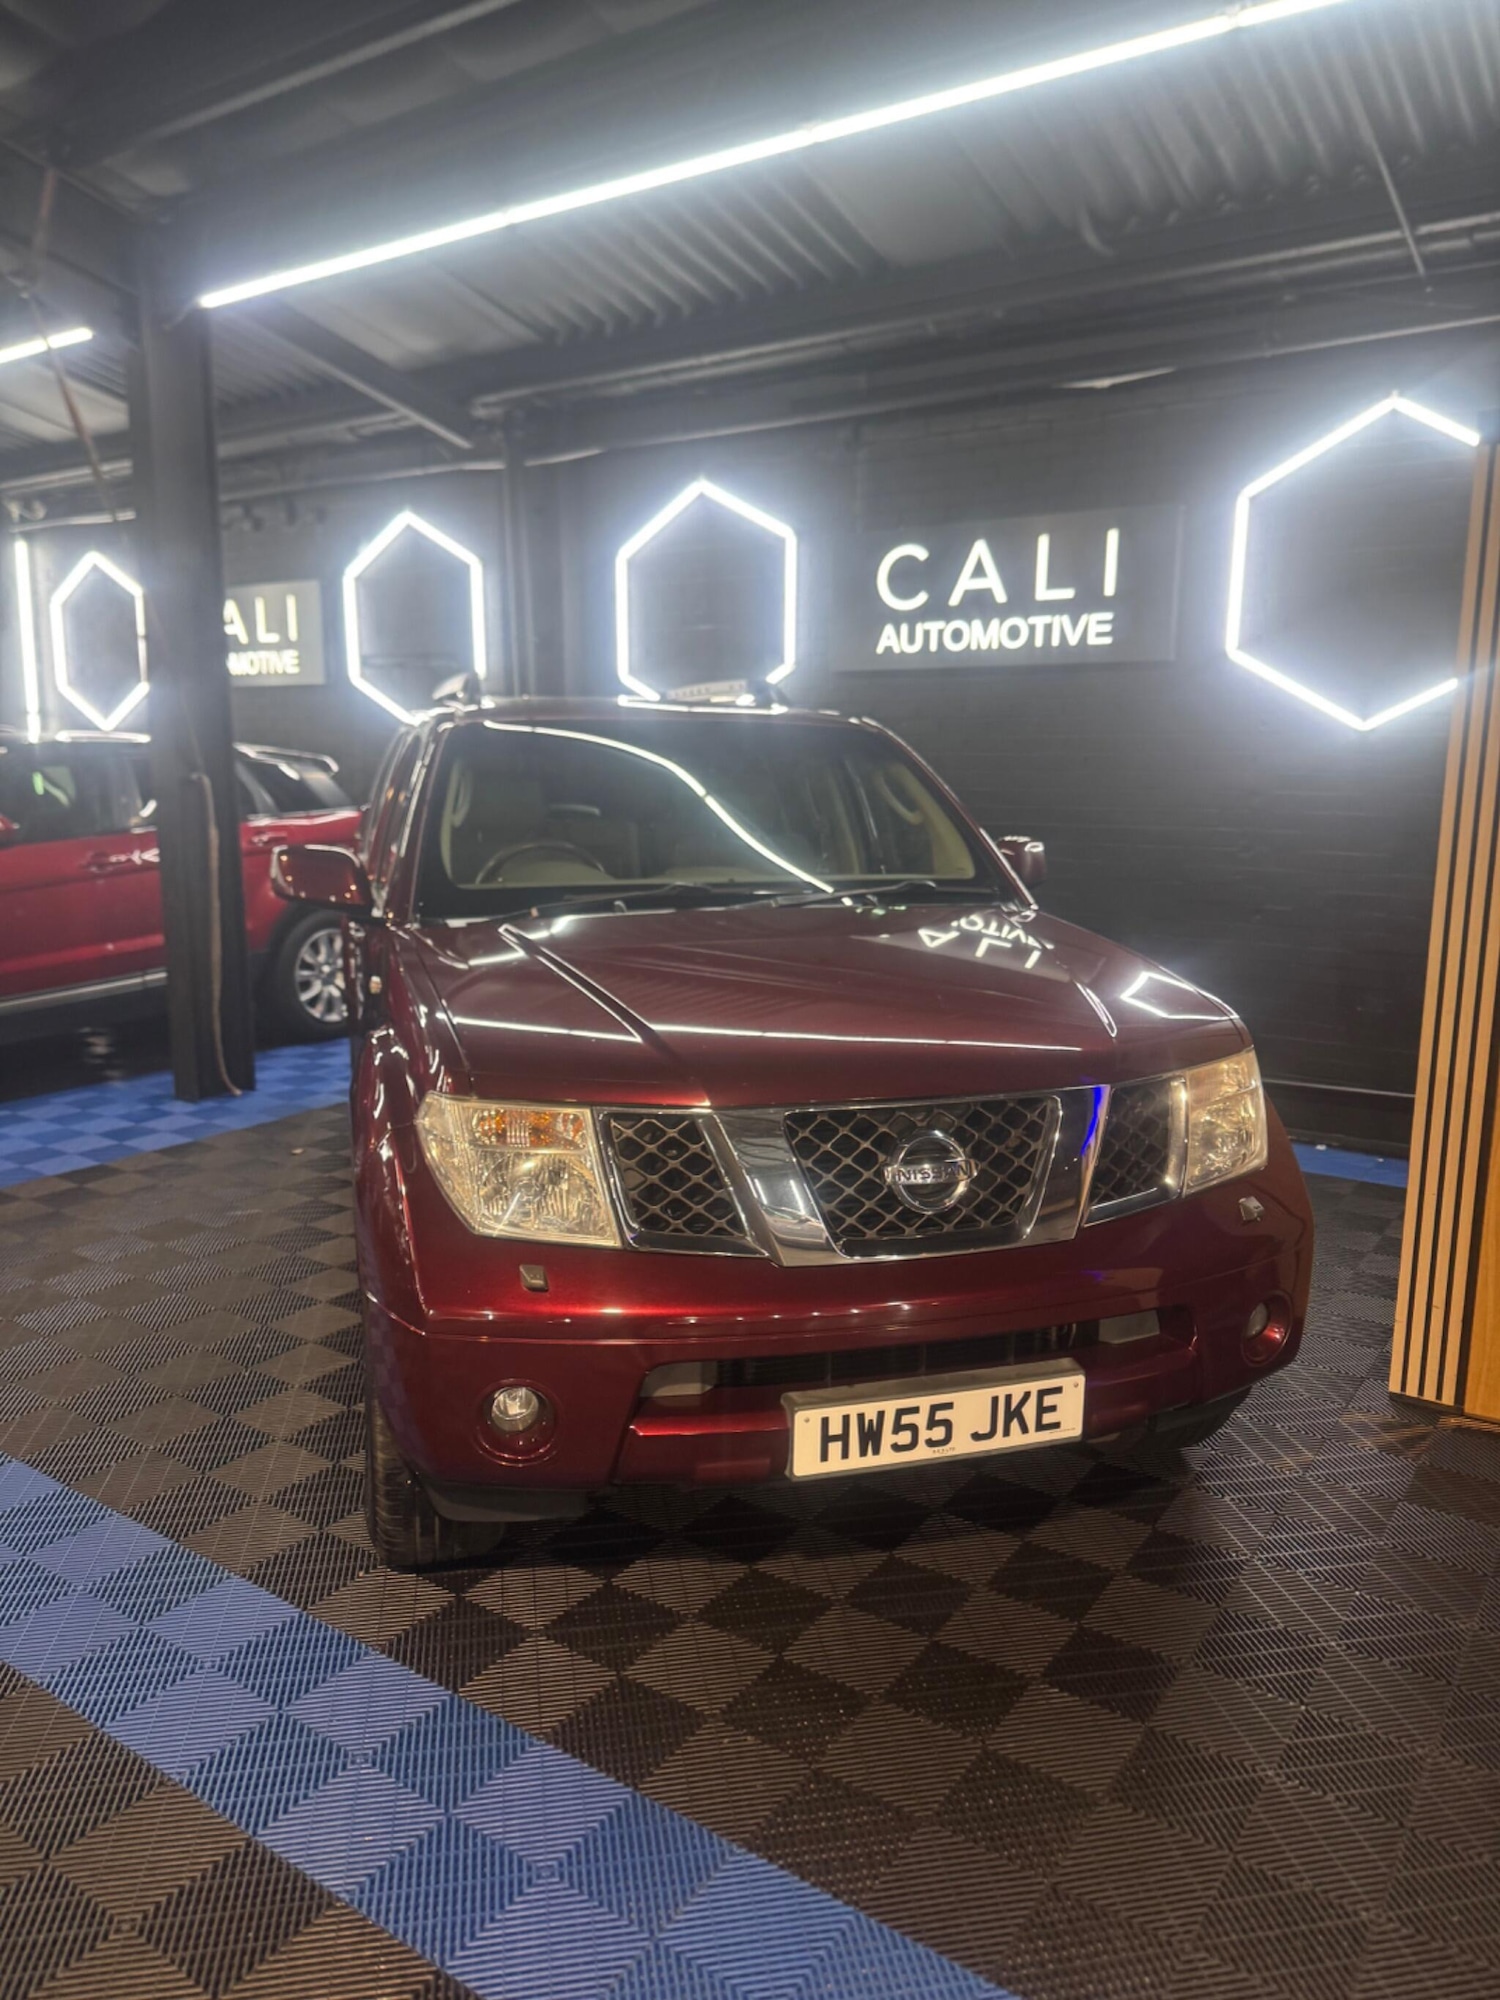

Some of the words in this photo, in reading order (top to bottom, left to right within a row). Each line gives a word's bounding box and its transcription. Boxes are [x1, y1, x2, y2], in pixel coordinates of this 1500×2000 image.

[876, 527, 1119, 611] CALI
[226, 649, 300, 675] MOTIVE
[876, 612, 1114, 655] AUTOMOTIVE
[819, 1402, 954, 1463] HW55
[970, 1386, 1063, 1442] JKE
